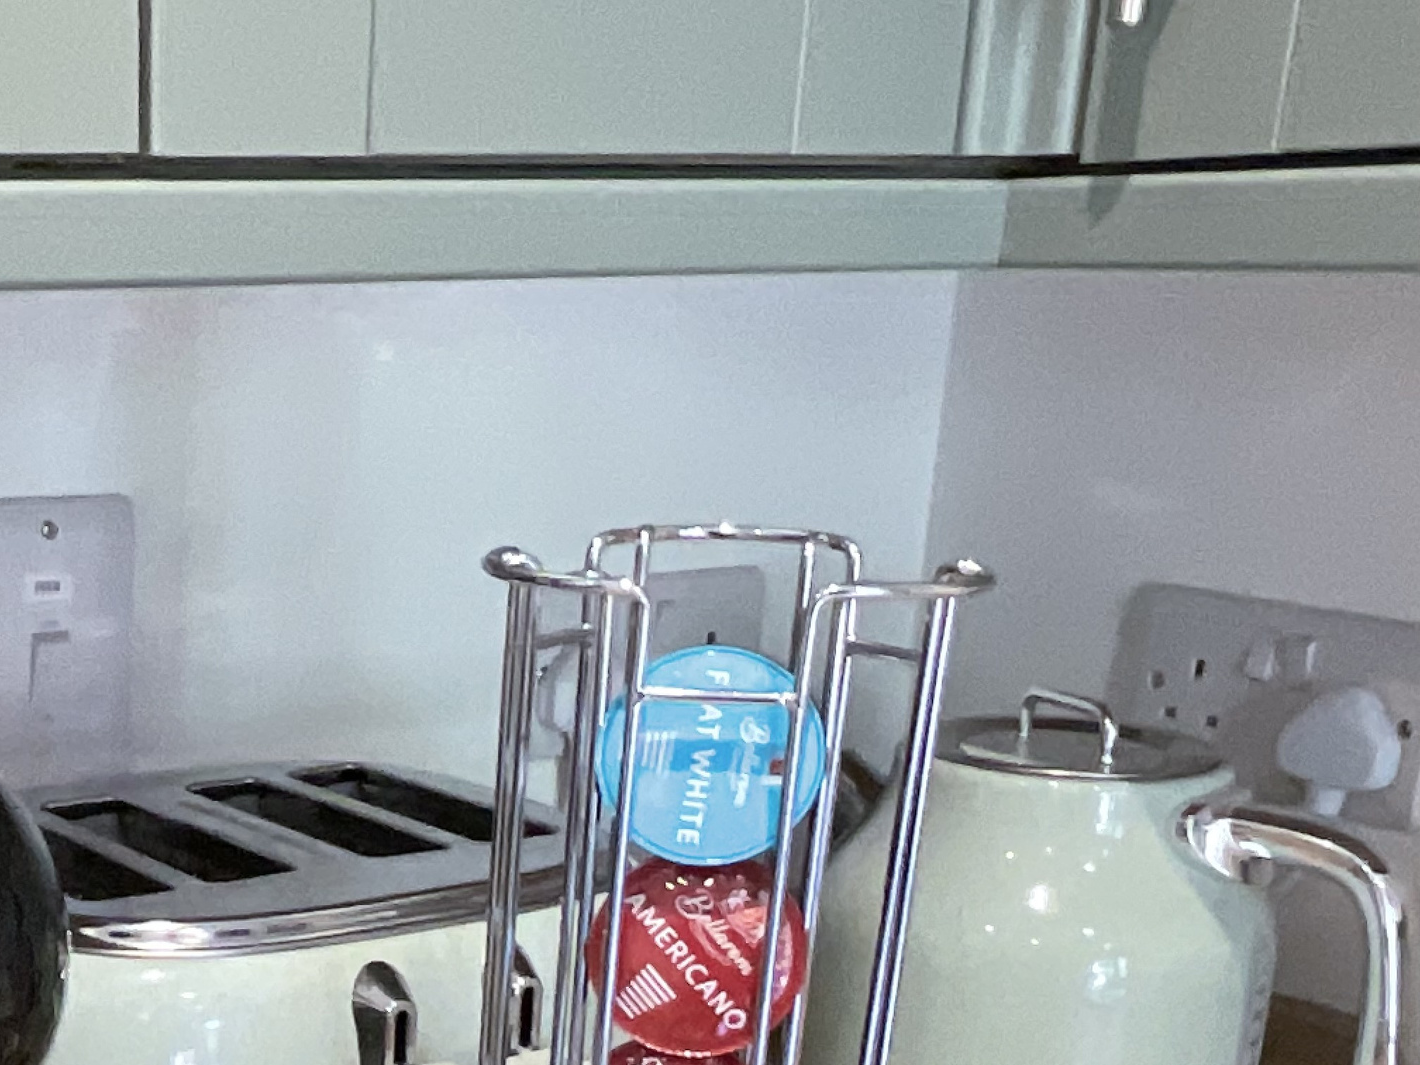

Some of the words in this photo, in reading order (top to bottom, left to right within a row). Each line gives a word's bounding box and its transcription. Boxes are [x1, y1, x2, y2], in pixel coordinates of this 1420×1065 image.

[696, 669, 730, 740] FAT
[676, 748, 717, 845] WHITE
[622, 893, 747, 1030] AMERICANO
